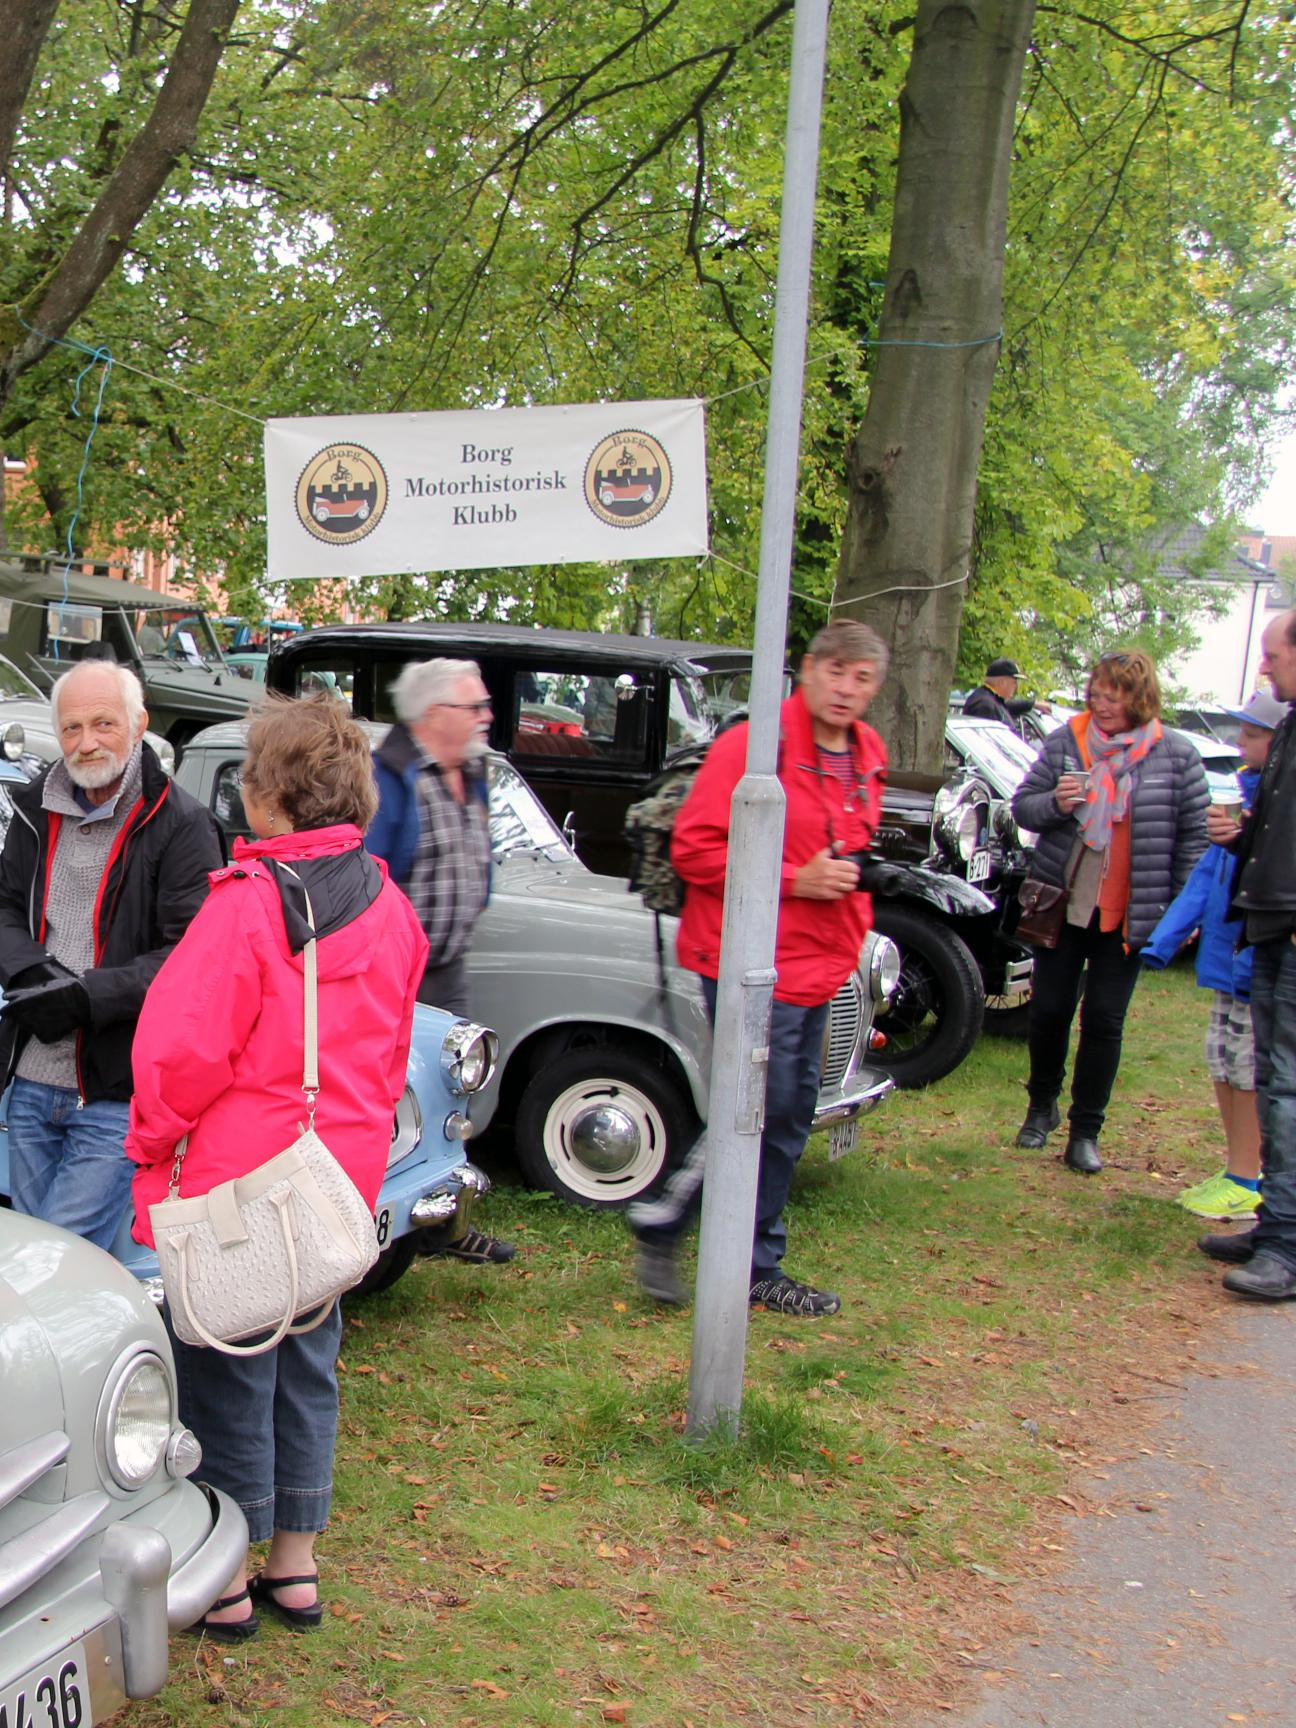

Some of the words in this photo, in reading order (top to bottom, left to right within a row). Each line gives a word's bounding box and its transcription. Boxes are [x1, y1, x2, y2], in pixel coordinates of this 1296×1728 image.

[612, 435, 647, 449] Borg
[326, 448, 362, 463] Borg
[461, 443, 514, 466] Borg
[404, 470, 567, 498] Motorhistorisk
[452, 503, 518, 526] Klubb
[373, 1208, 390, 1247] 8
